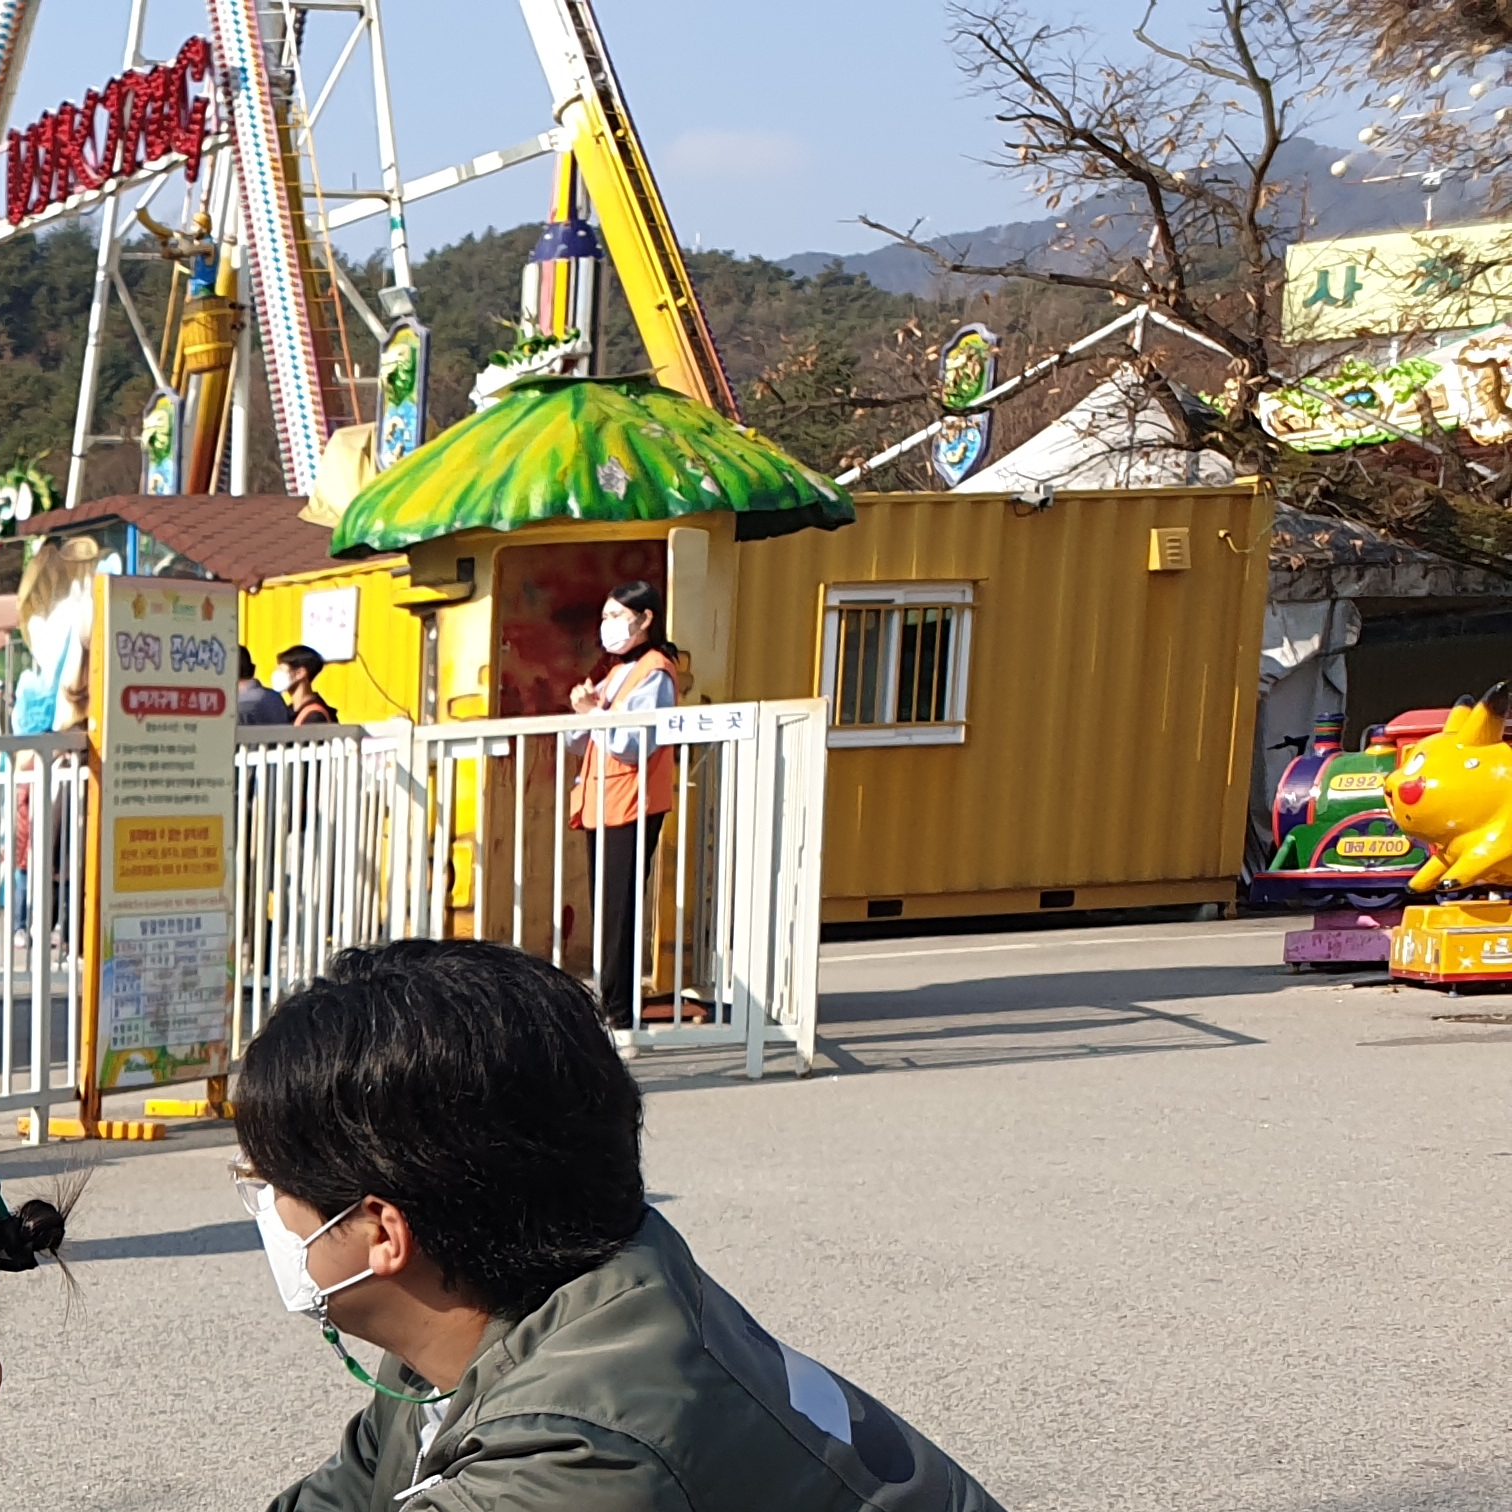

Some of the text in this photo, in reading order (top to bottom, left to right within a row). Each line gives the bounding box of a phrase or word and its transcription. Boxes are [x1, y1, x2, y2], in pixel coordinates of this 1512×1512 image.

[170, 633, 226, 676] 준수사항
[1338, 775, 1378, 788] 1992
[1368, 840, 1404, 852] 4700
